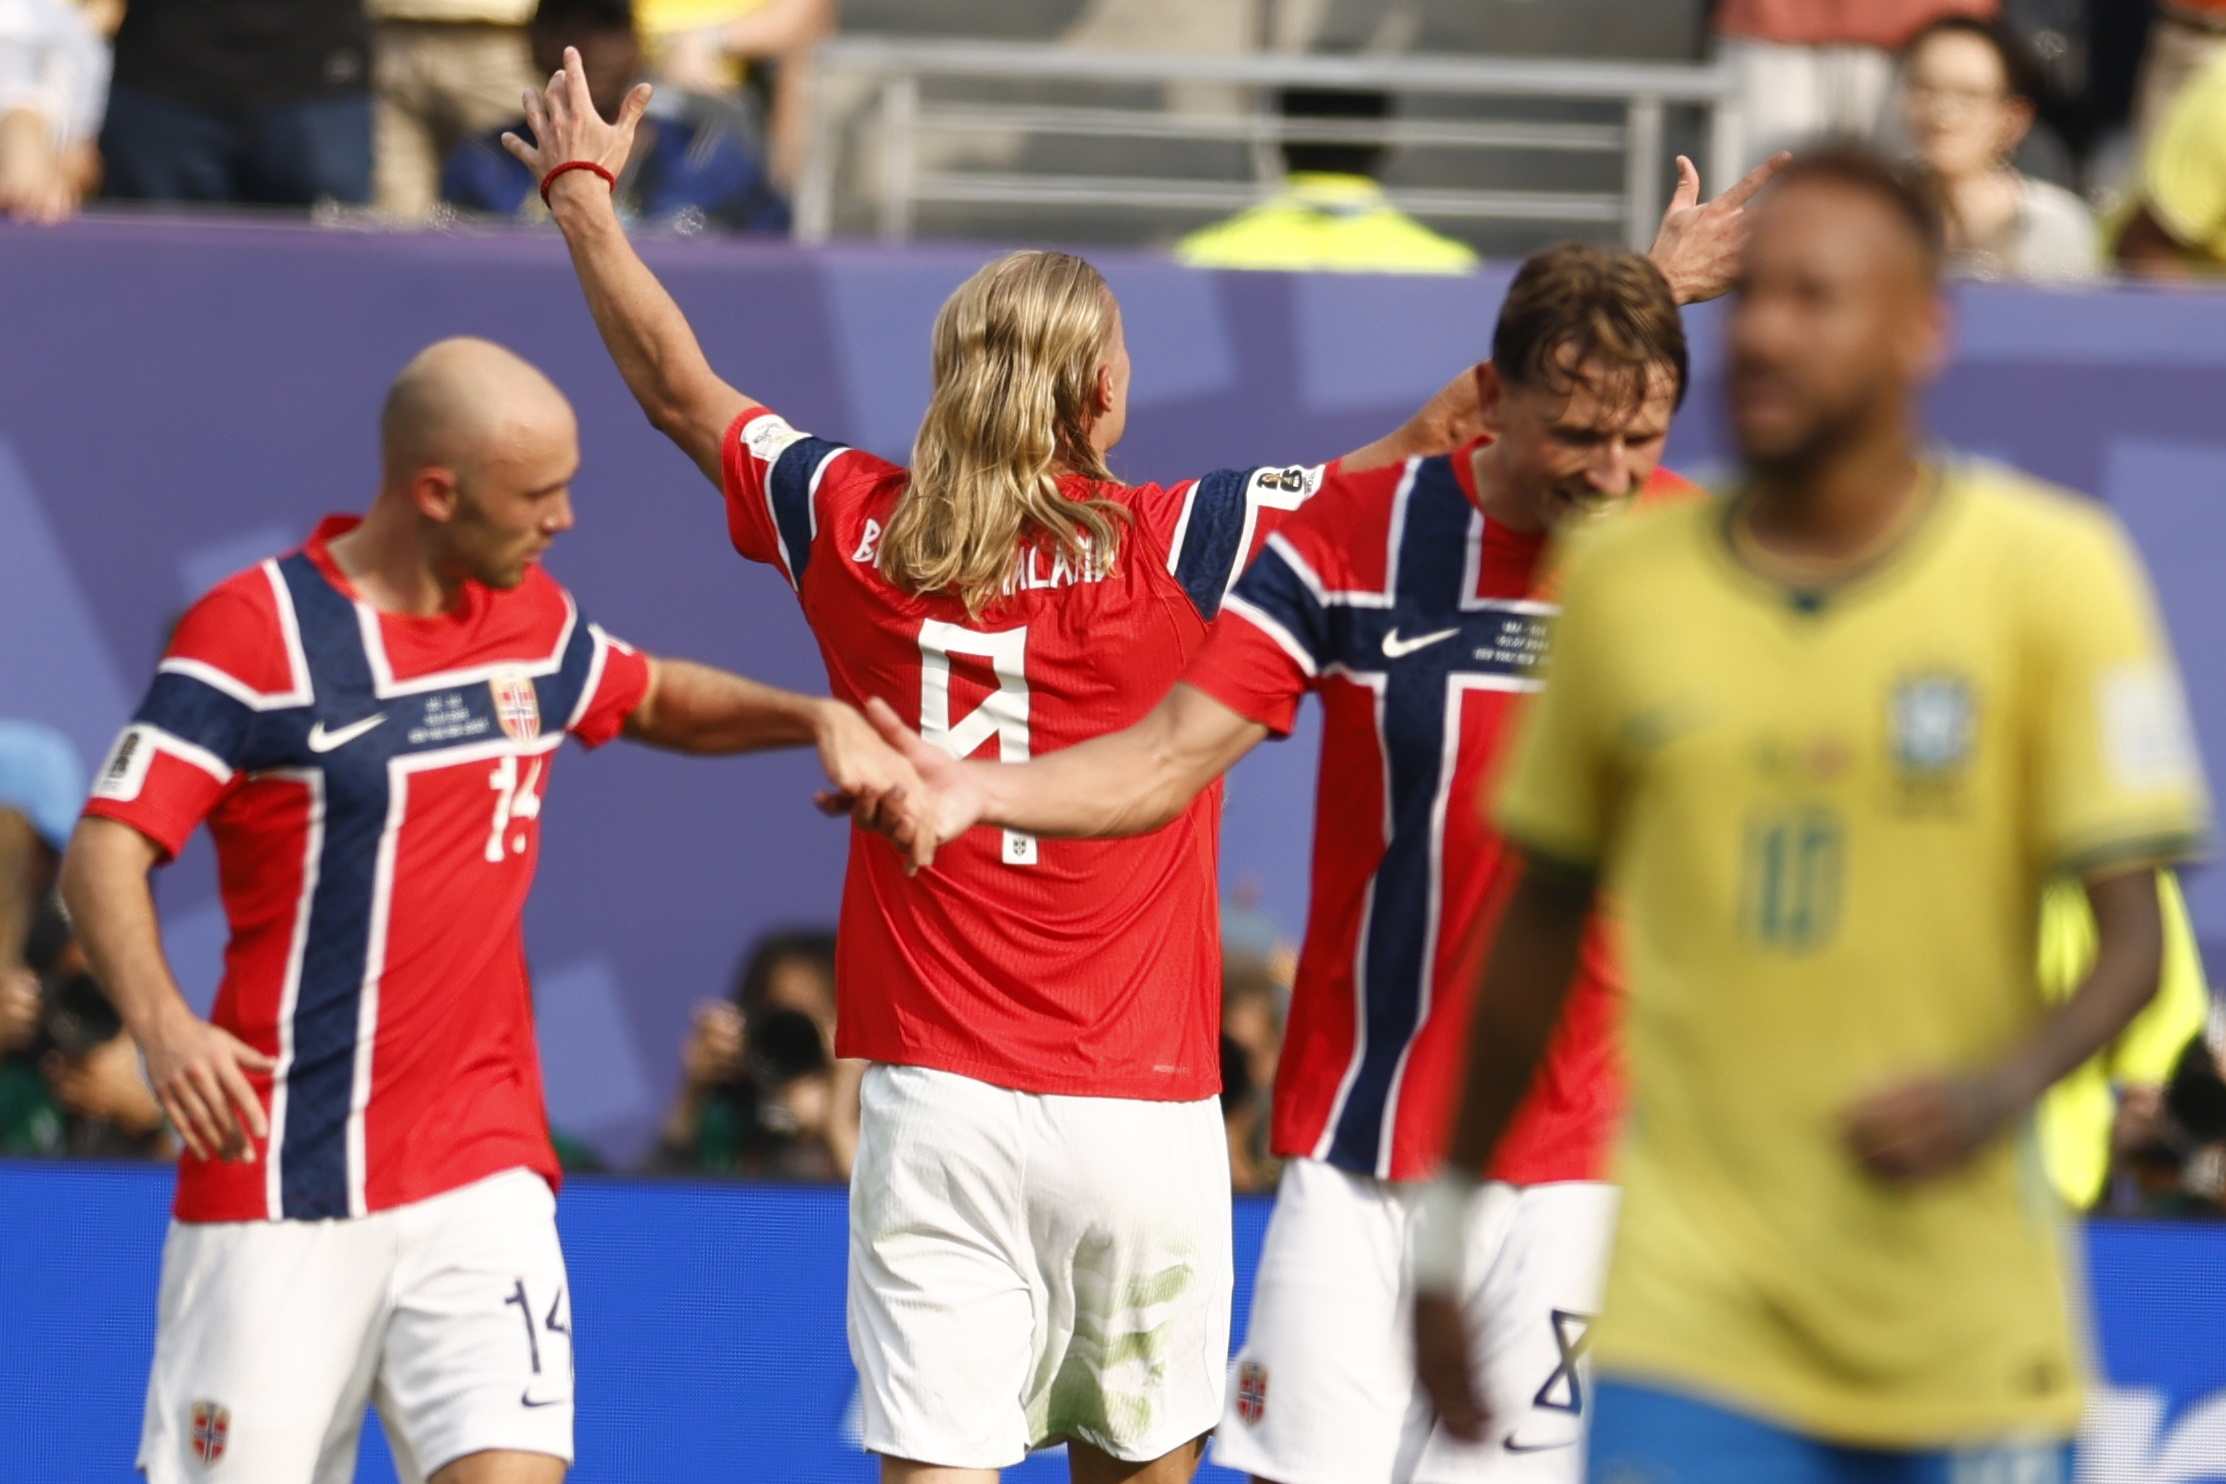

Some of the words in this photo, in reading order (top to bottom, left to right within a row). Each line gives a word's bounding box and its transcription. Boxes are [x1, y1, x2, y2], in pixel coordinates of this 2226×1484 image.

[917, 617, 1038, 865] 9
[484, 754, 541, 863] 14
[504, 1278, 572, 1375] 14
[1532, 1308, 1596, 1417] 8
